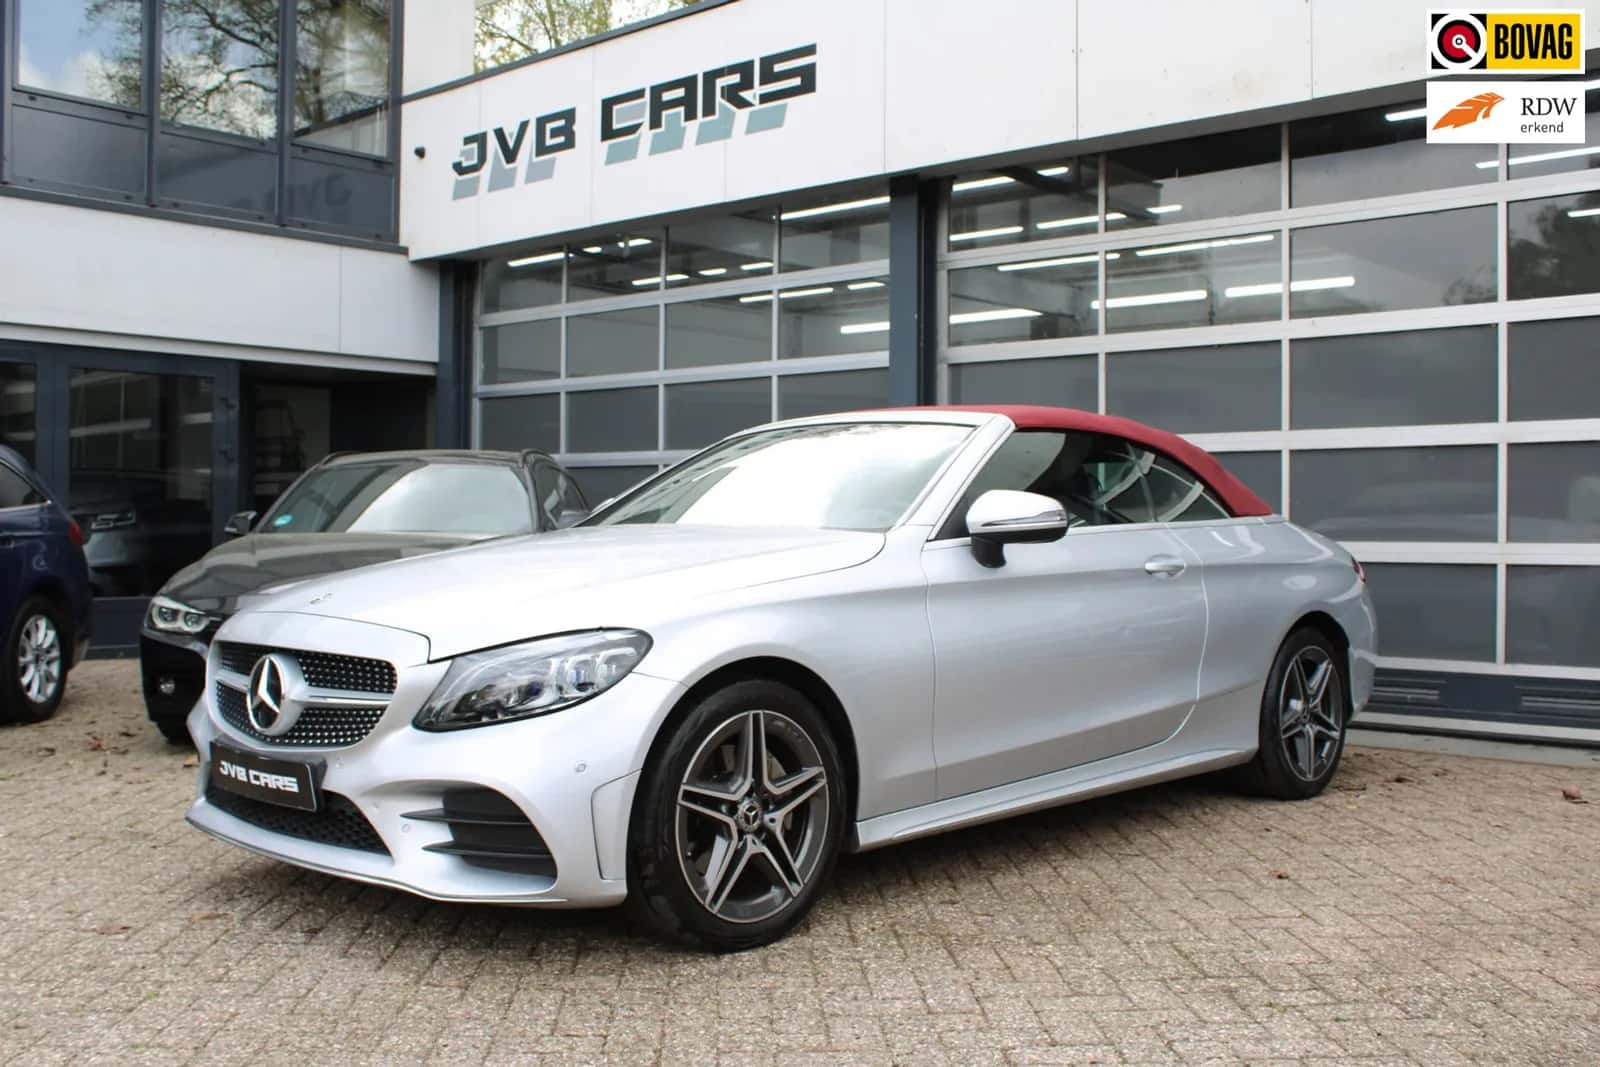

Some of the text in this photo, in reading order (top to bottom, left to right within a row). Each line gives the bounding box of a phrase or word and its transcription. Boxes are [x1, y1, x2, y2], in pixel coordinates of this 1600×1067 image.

[452, 43, 817, 176] JVB CARS
[219, 760, 299, 792] JVB CARS
